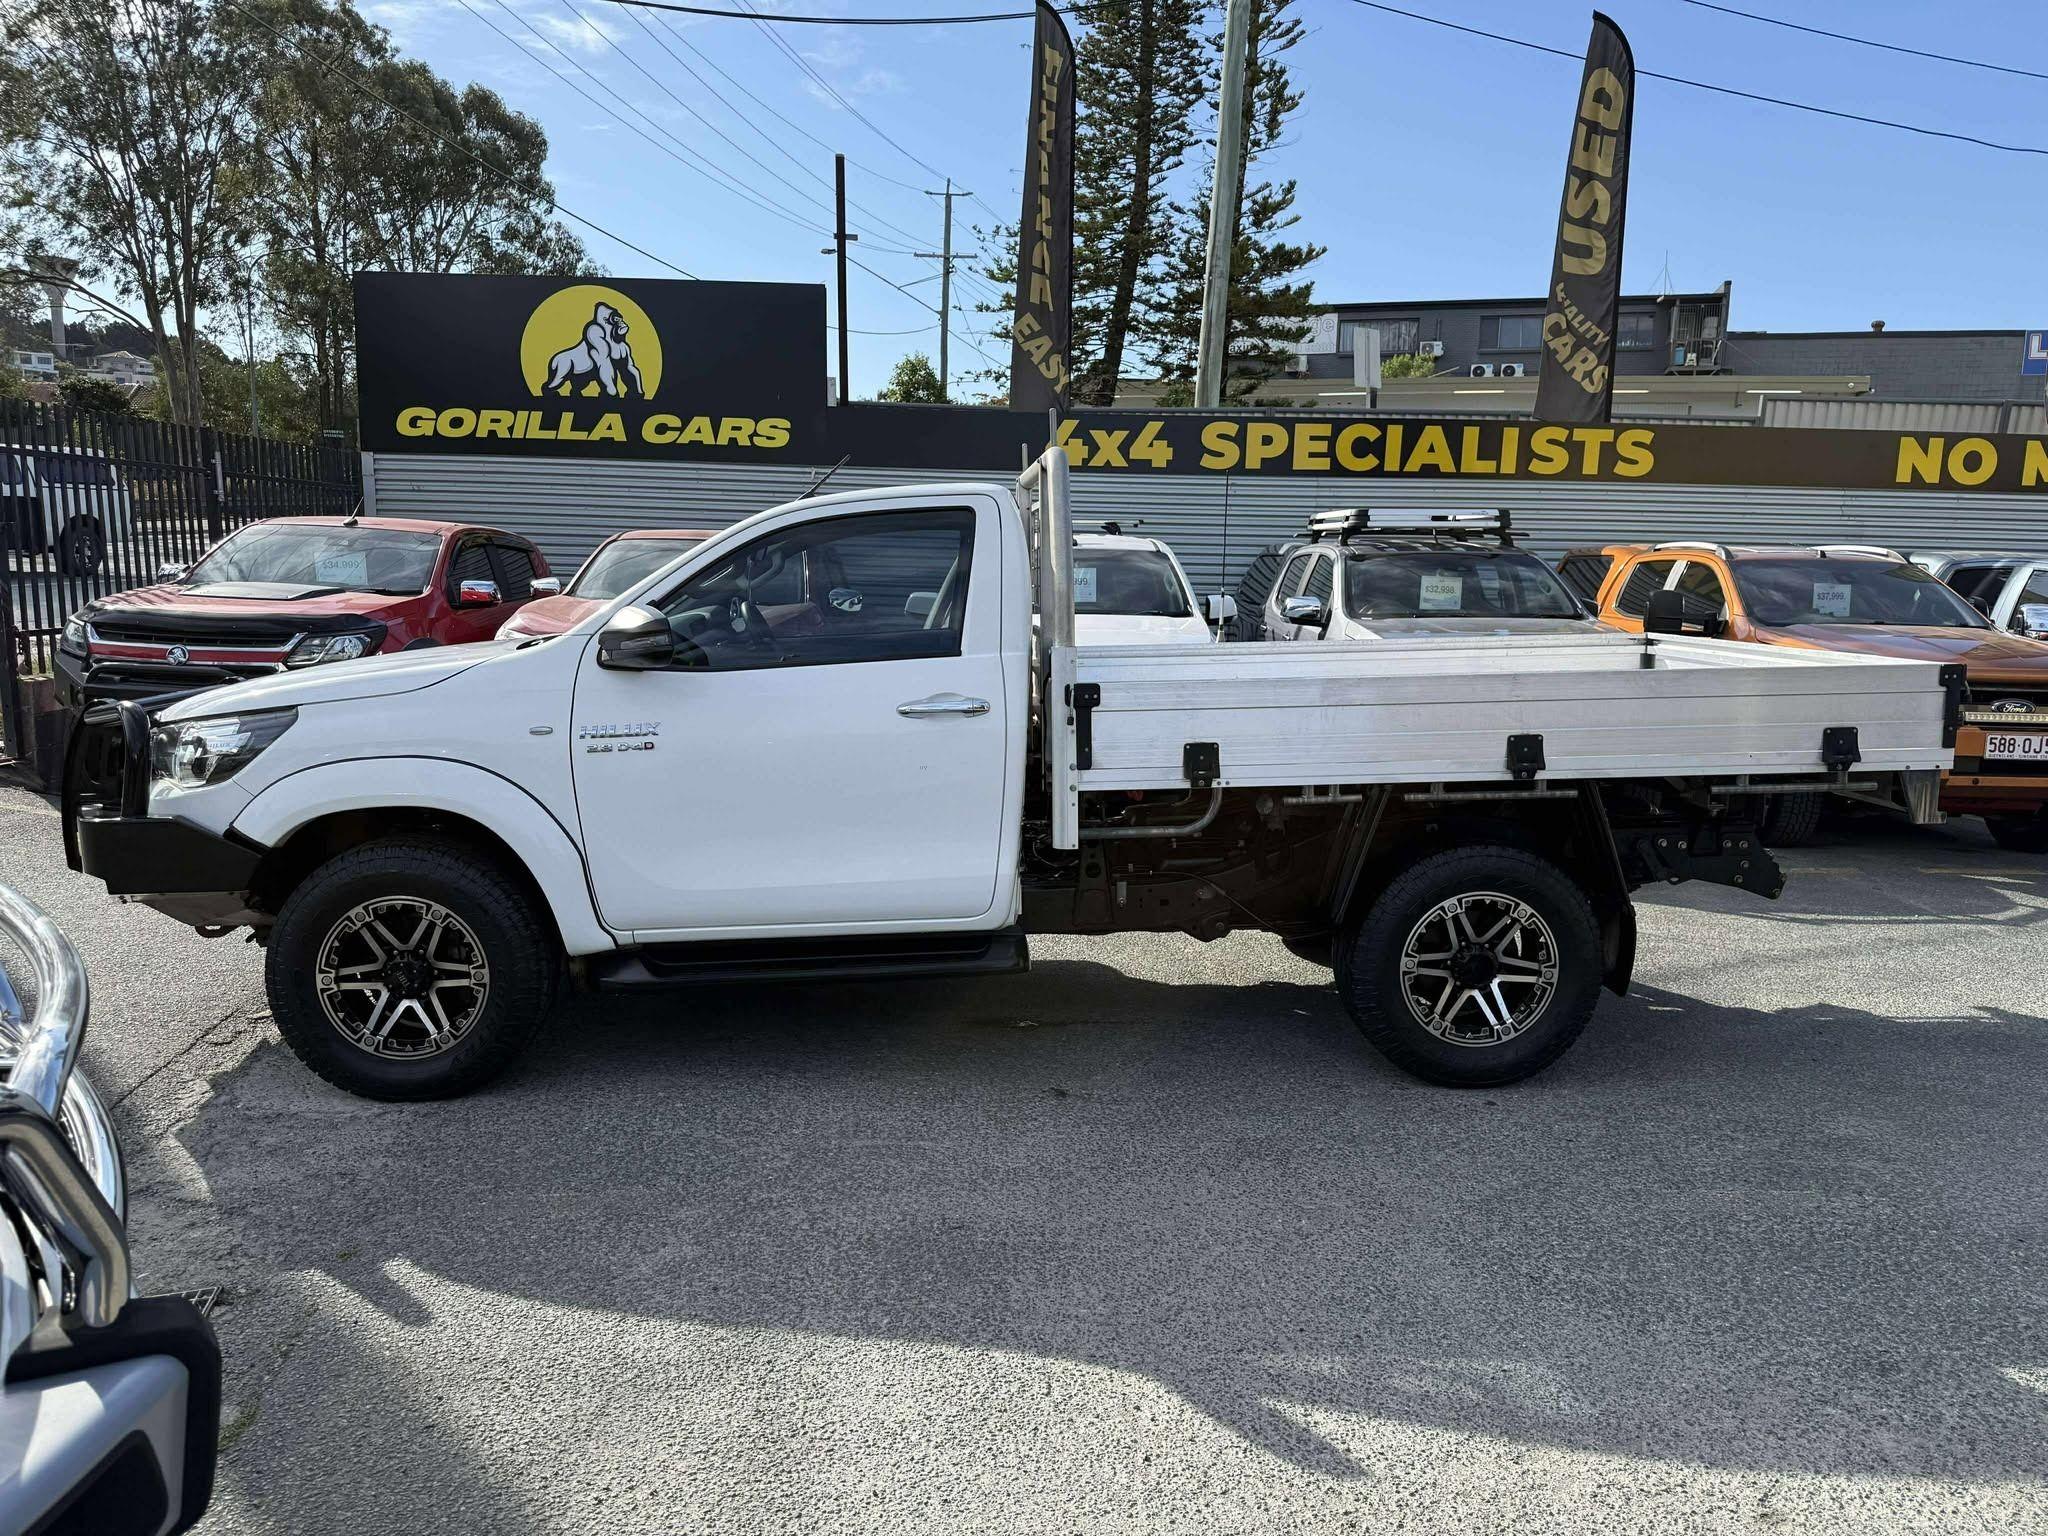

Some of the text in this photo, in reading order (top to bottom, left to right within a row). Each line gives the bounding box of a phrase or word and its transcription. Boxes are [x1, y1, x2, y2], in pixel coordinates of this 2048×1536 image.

[1562, 67, 1624, 275] USED
[1013, 312, 1069, 394] EASY
[1543, 312, 1609, 393] CARS
[396, 406, 791, 448] GORILLA CARS
[1045, 419, 1655, 477] 4x4 SPECIALISTS
[1896, 436, 2048, 487] NO M
[2003, 703, 2028, 713] Ford
